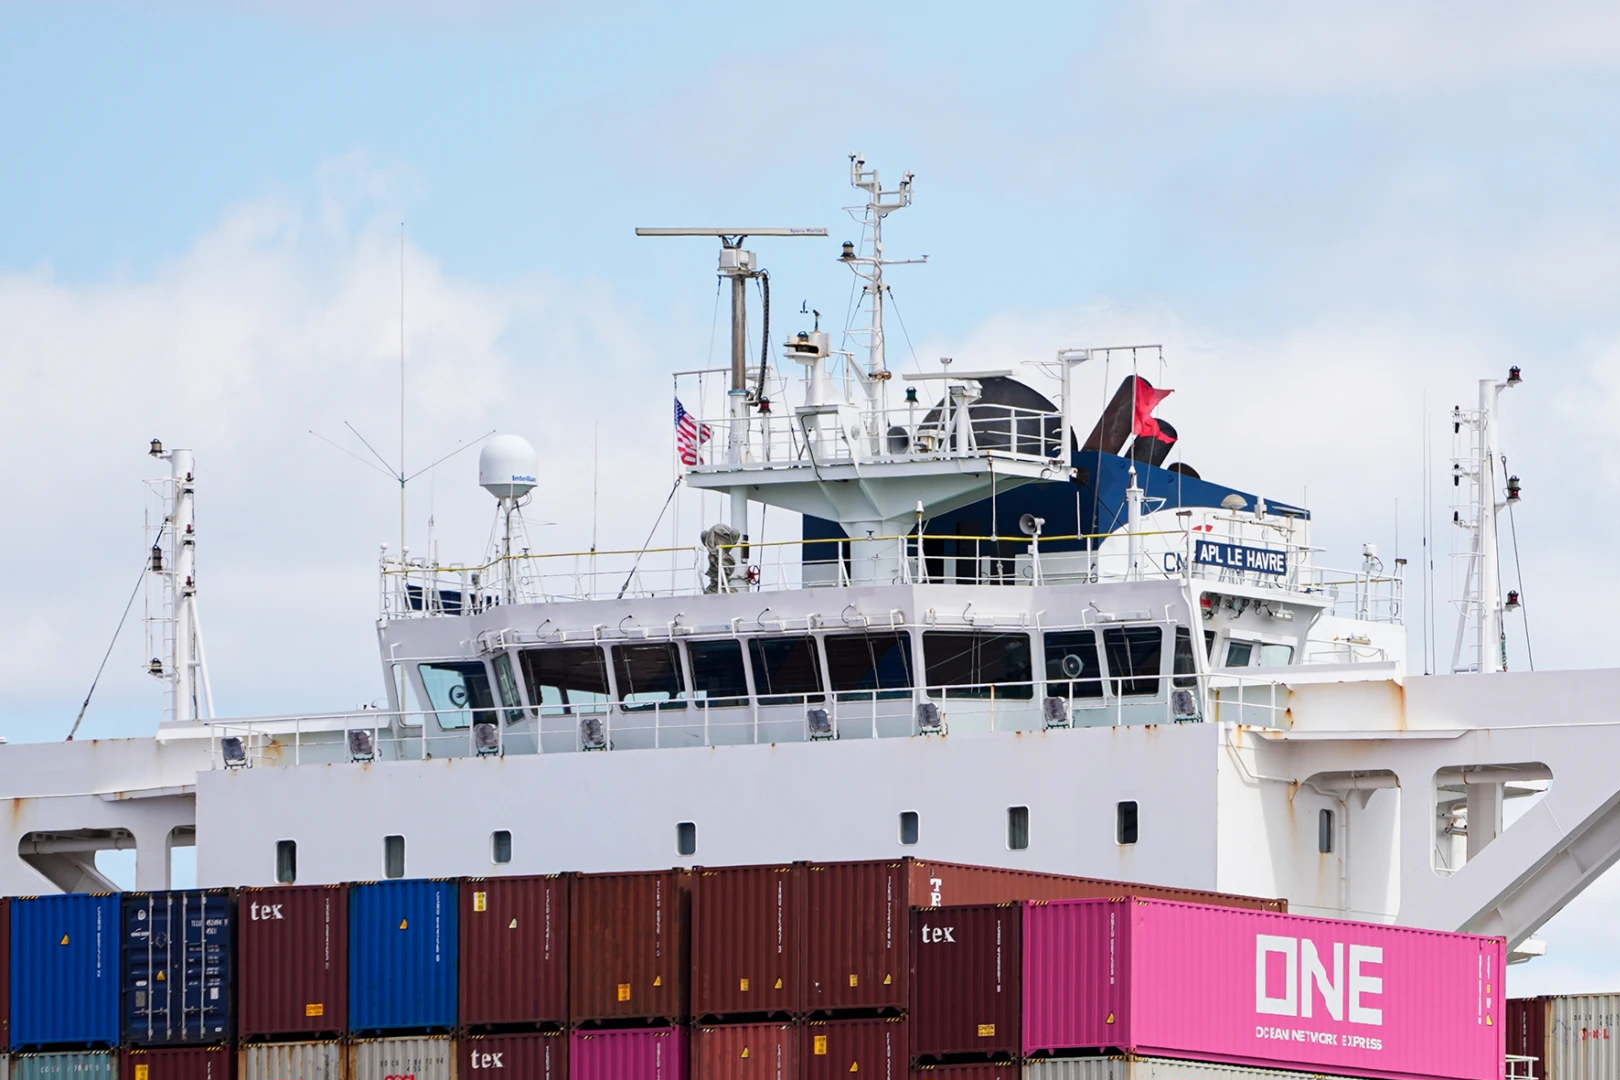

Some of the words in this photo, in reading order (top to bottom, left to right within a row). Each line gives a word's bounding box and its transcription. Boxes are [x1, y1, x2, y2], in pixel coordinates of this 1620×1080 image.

[1200, 544, 1223, 563] APL
[1227, 547, 1243, 566] LE
[1246, 550, 1285, 572] HAVRE
[250, 901, 283, 921] tex
[921, 924, 956, 944] tex
[1256, 934, 1383, 1026] ONE
[1255, 1026, 1290, 1041] OCEAN
[1291, 1029, 1338, 1046] NETWORK
[1342, 1034, 1383, 1051] EXPRESS
[470, 1049, 504, 1069] tex
